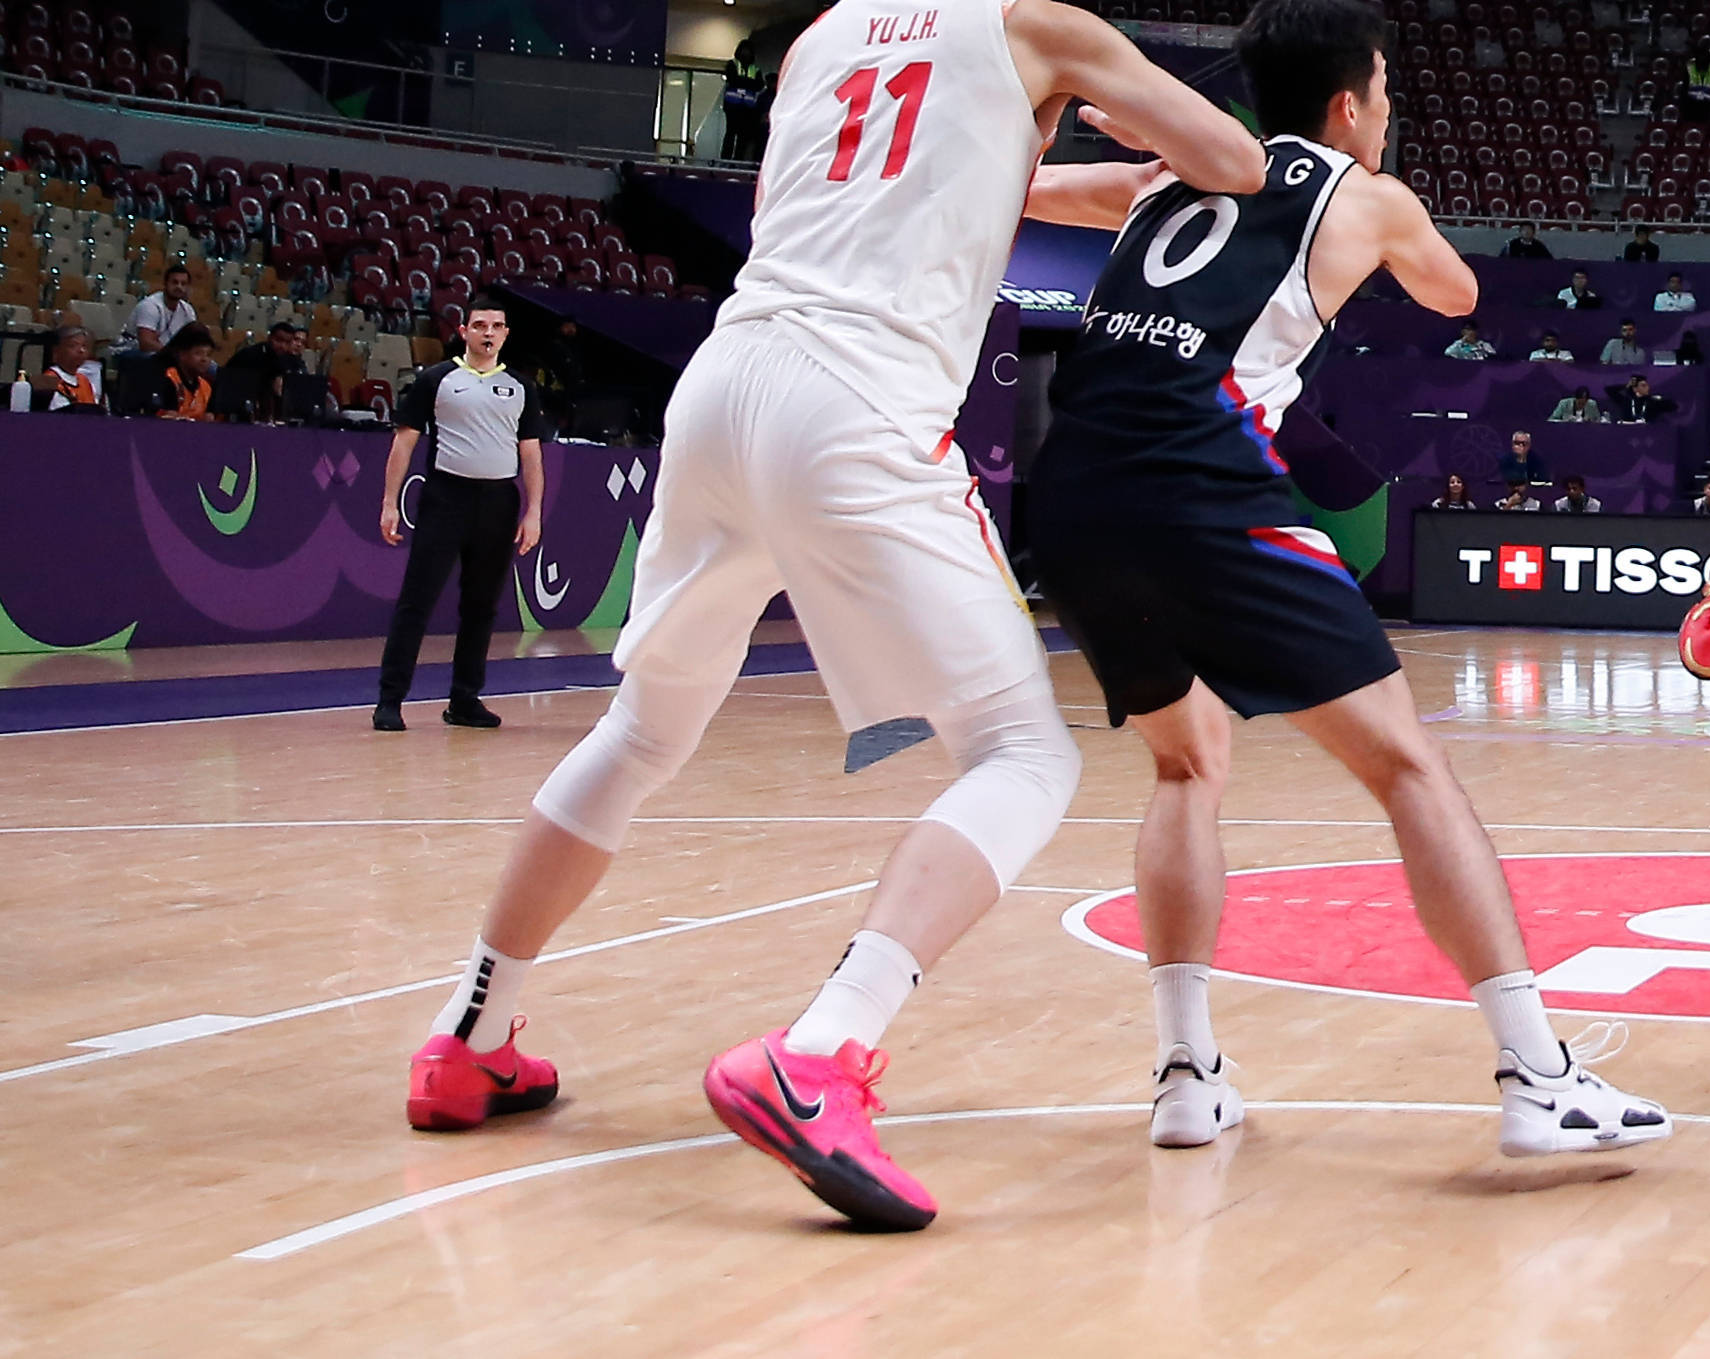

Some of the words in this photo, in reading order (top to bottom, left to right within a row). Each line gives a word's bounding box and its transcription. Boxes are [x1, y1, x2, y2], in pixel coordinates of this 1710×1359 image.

[866, 16, 896, 46] YU
[899, 9, 939, 43] J.H.
[827, 61, 933, 183] 11
[1143, 195, 1239, 288] 0
[1106, 312, 1207, 359] 하나은행
